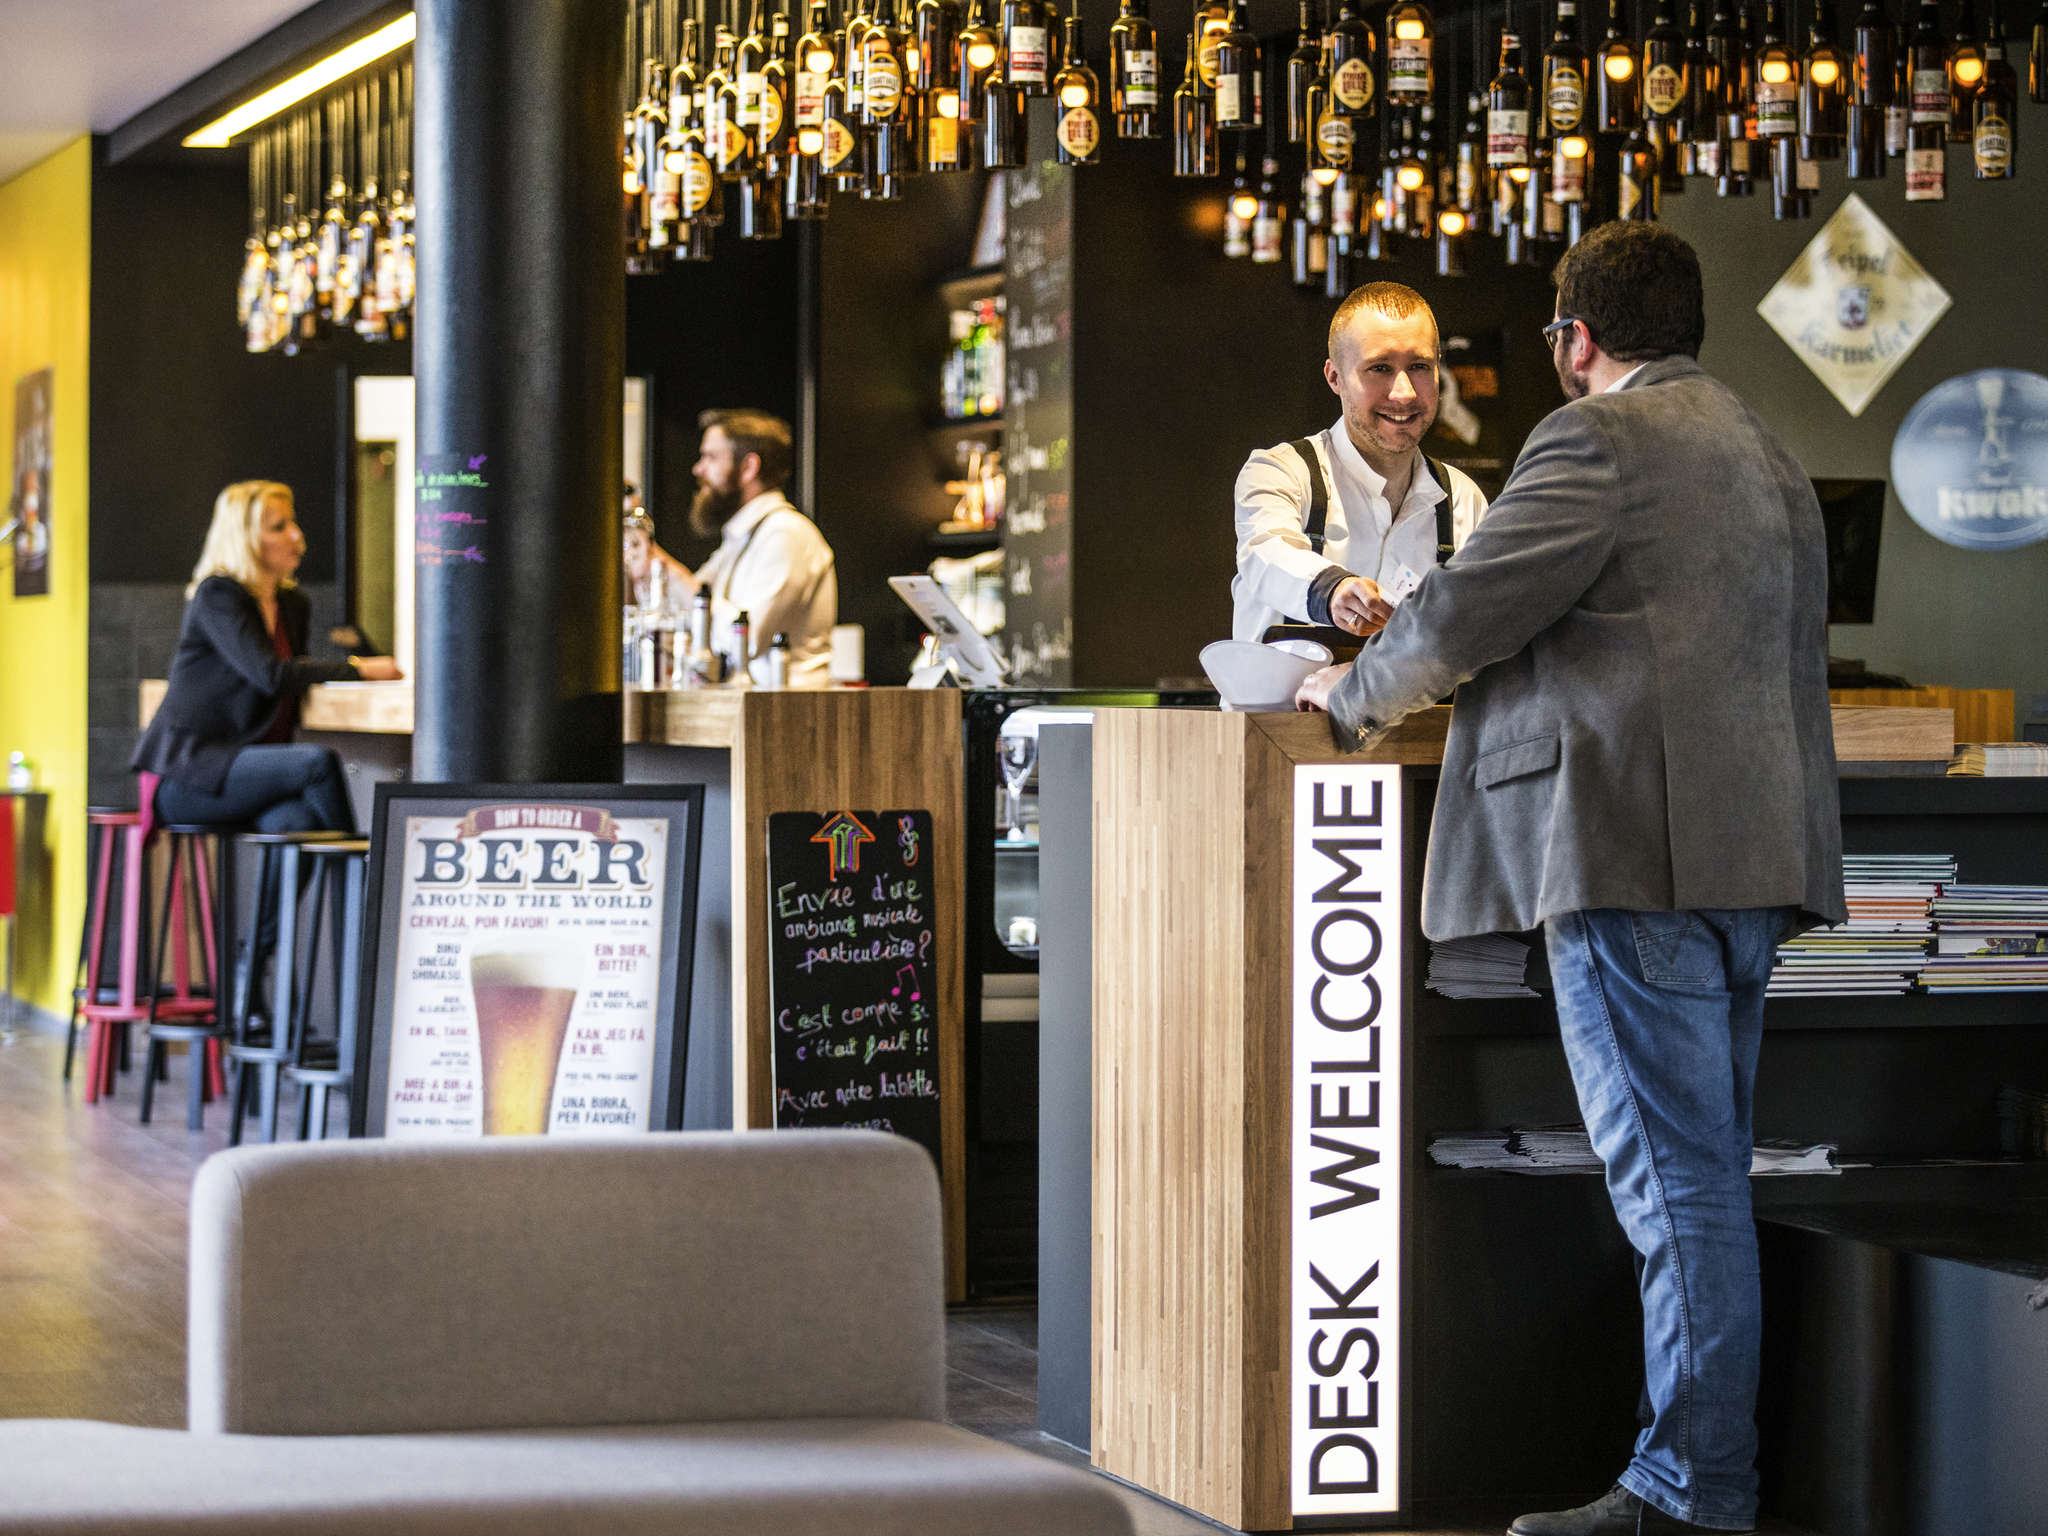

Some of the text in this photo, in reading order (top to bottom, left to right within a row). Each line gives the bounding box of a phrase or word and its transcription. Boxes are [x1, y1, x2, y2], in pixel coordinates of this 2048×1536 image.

[494, 808, 582, 828] HOW TO ORDER A
[414, 839, 653, 890] BEER
[410, 894, 653, 909] AROUND THE WORLD
[776, 872, 923, 918] Envie d'une
[409, 916, 549, 929] CERVEJA, POR FAVOR!
[784, 904, 923, 939] ambiance musicale
[594, 944, 651, 959] EIN BIER,
[598, 959, 637, 972] BITTE!
[778, 1000, 930, 1038] C'est comme si
[576, 1028, 600, 1040] KAN
[604, 1028, 626, 1040] JEG
[572, 1043, 587, 1054] EN
[864, 1029, 910, 1065] fait
[562, 1096, 586, 1109] UNA
[777, 1087, 829, 1112] Avec
[836, 1079, 873, 1108] notre
[557, 1111, 637, 1125] PER FAVORE!
[1309, 781, 1382, 1495] DESK WELCOME
